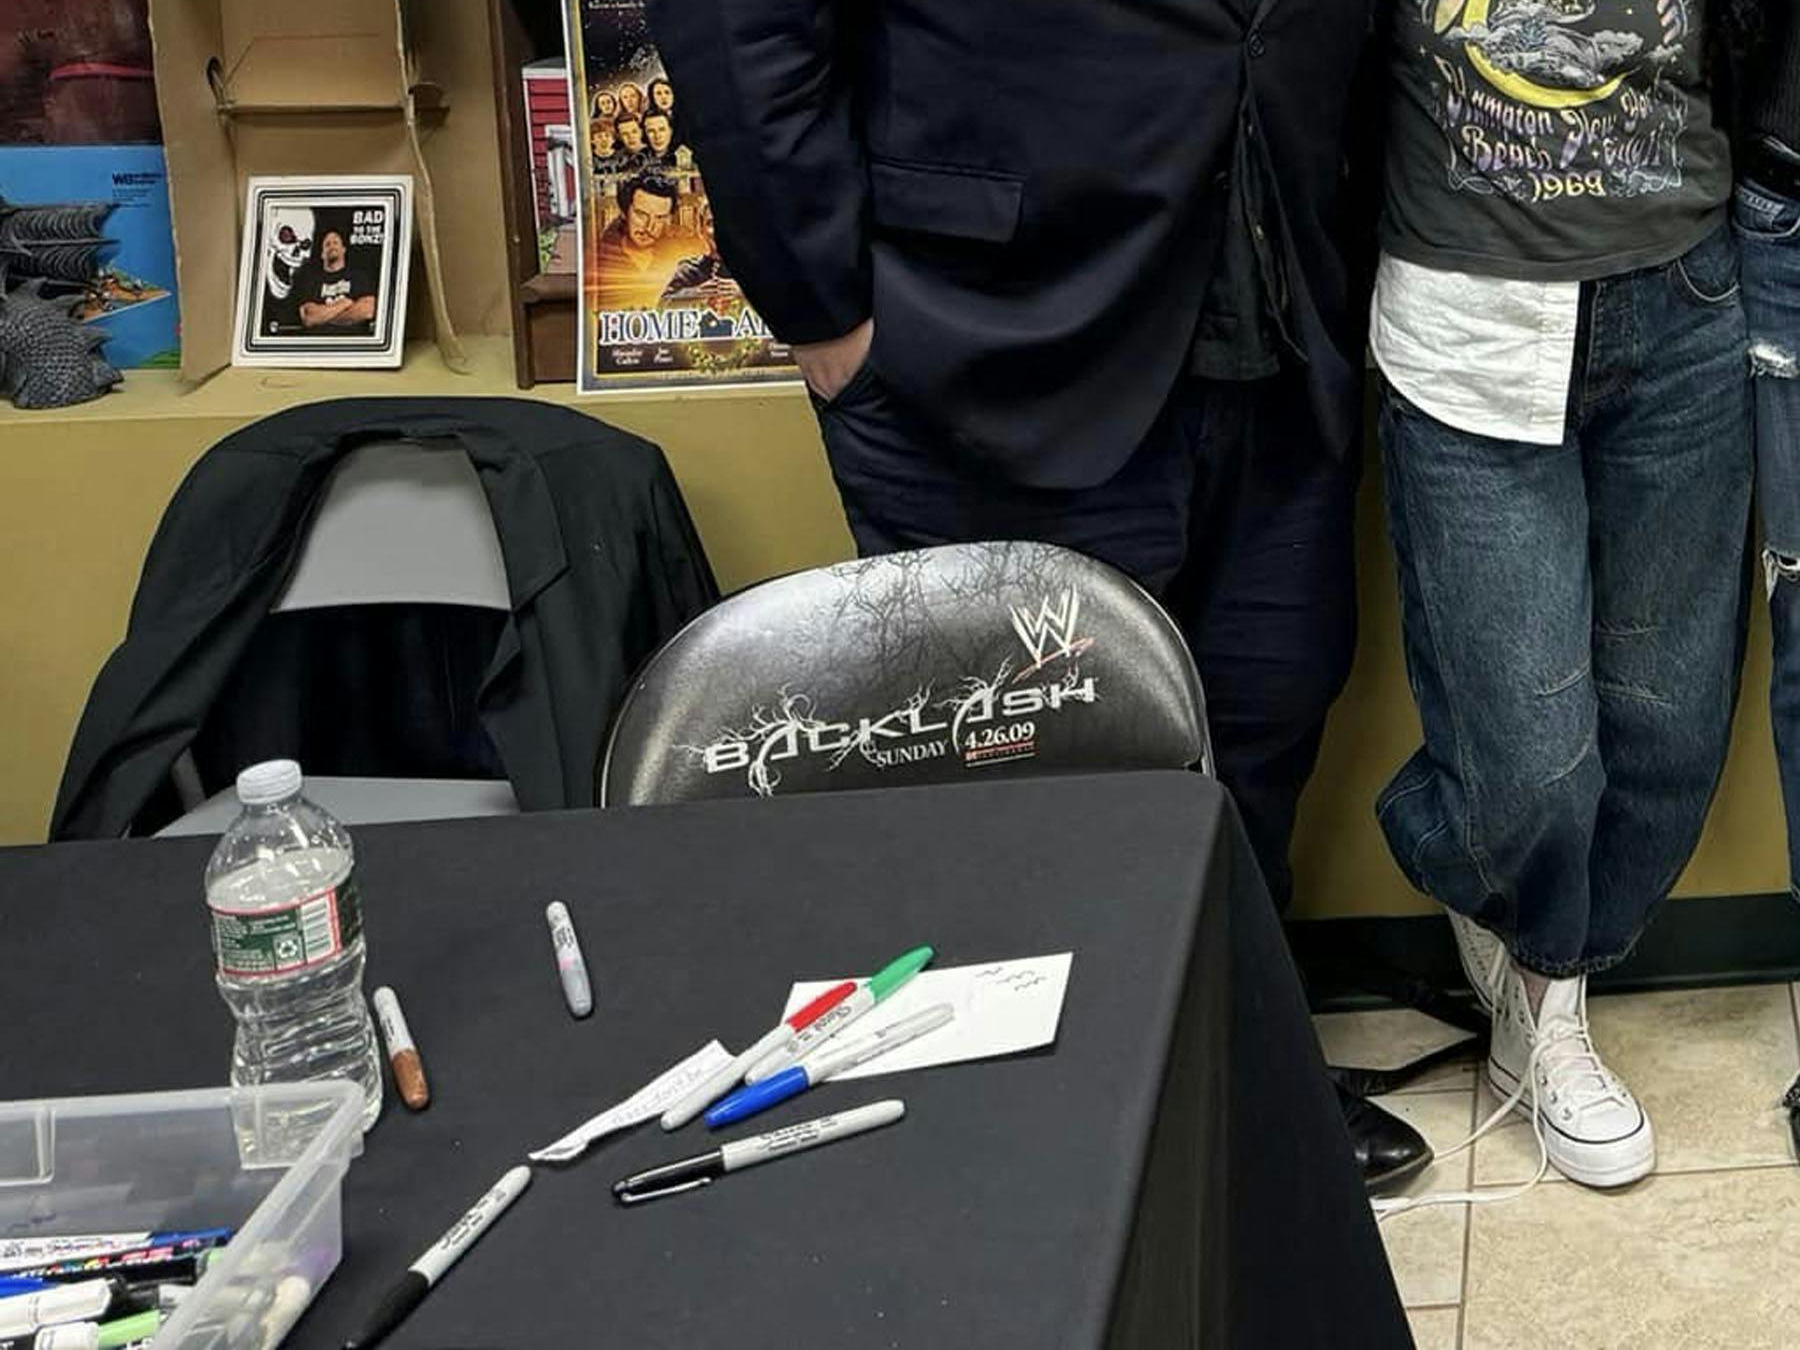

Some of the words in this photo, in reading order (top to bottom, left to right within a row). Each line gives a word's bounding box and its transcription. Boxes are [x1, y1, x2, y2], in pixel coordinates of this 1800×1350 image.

[1527, 172, 1606, 202] 1969
[599, 310, 699, 345] HOME
[875, 738, 950, 767] SUNDAY
[965, 720, 1036, 749] 4.26.09
